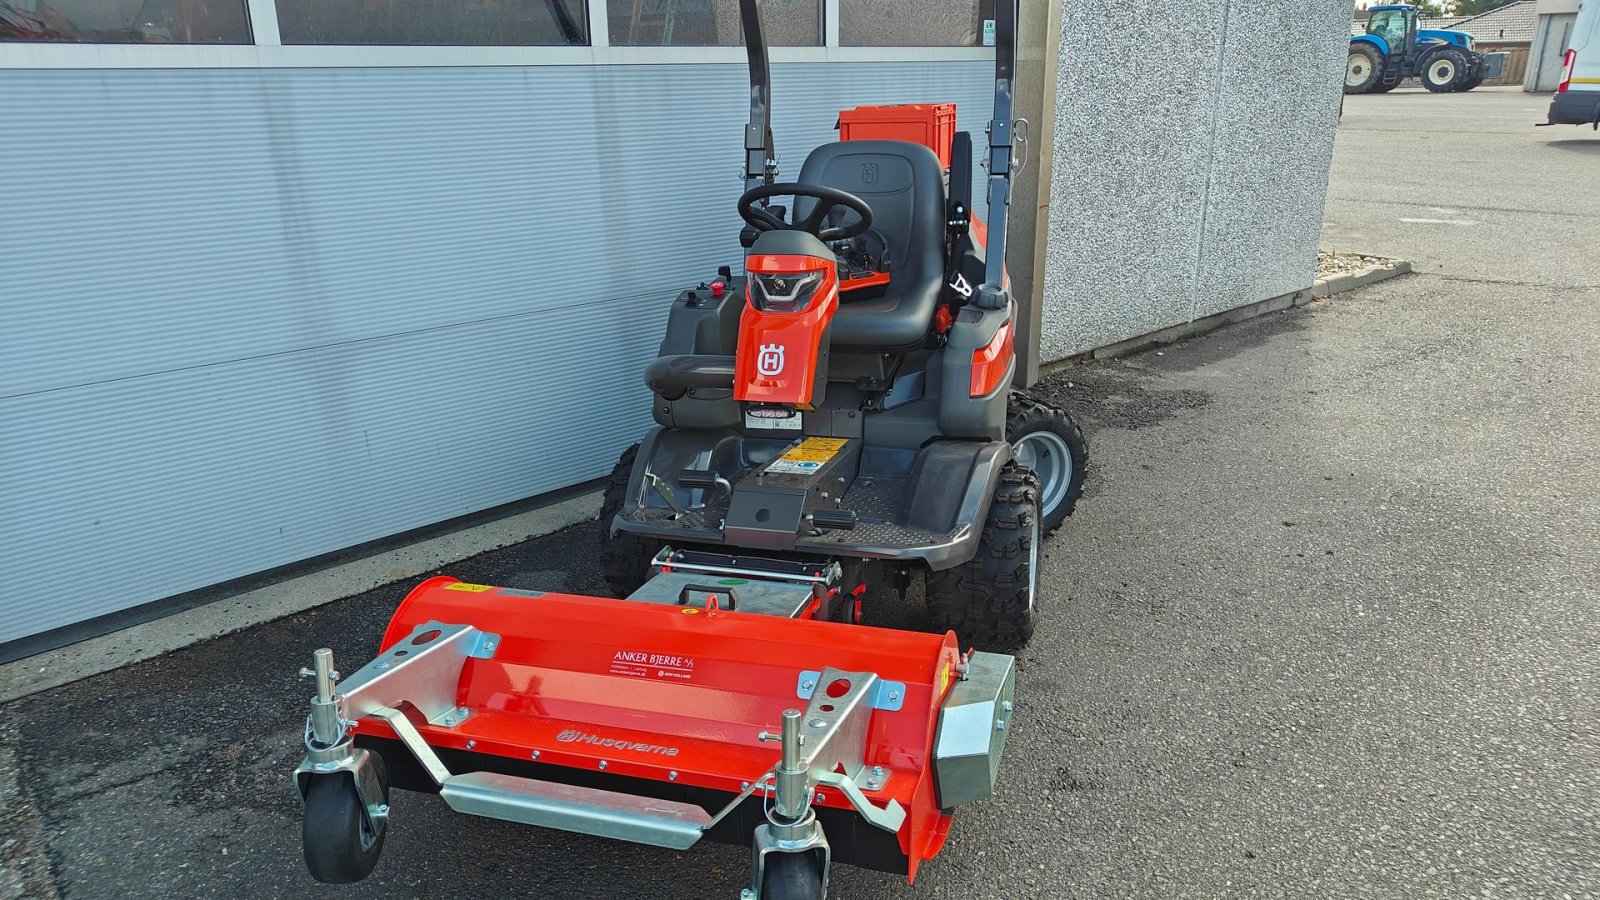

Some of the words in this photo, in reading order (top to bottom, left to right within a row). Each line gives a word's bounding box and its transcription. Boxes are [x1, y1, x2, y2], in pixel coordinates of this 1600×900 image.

[614, 651, 648, 662] ANKER
[649, 654, 682, 667] BJERRE
[577, 734, 680, 756] Husqvarna
